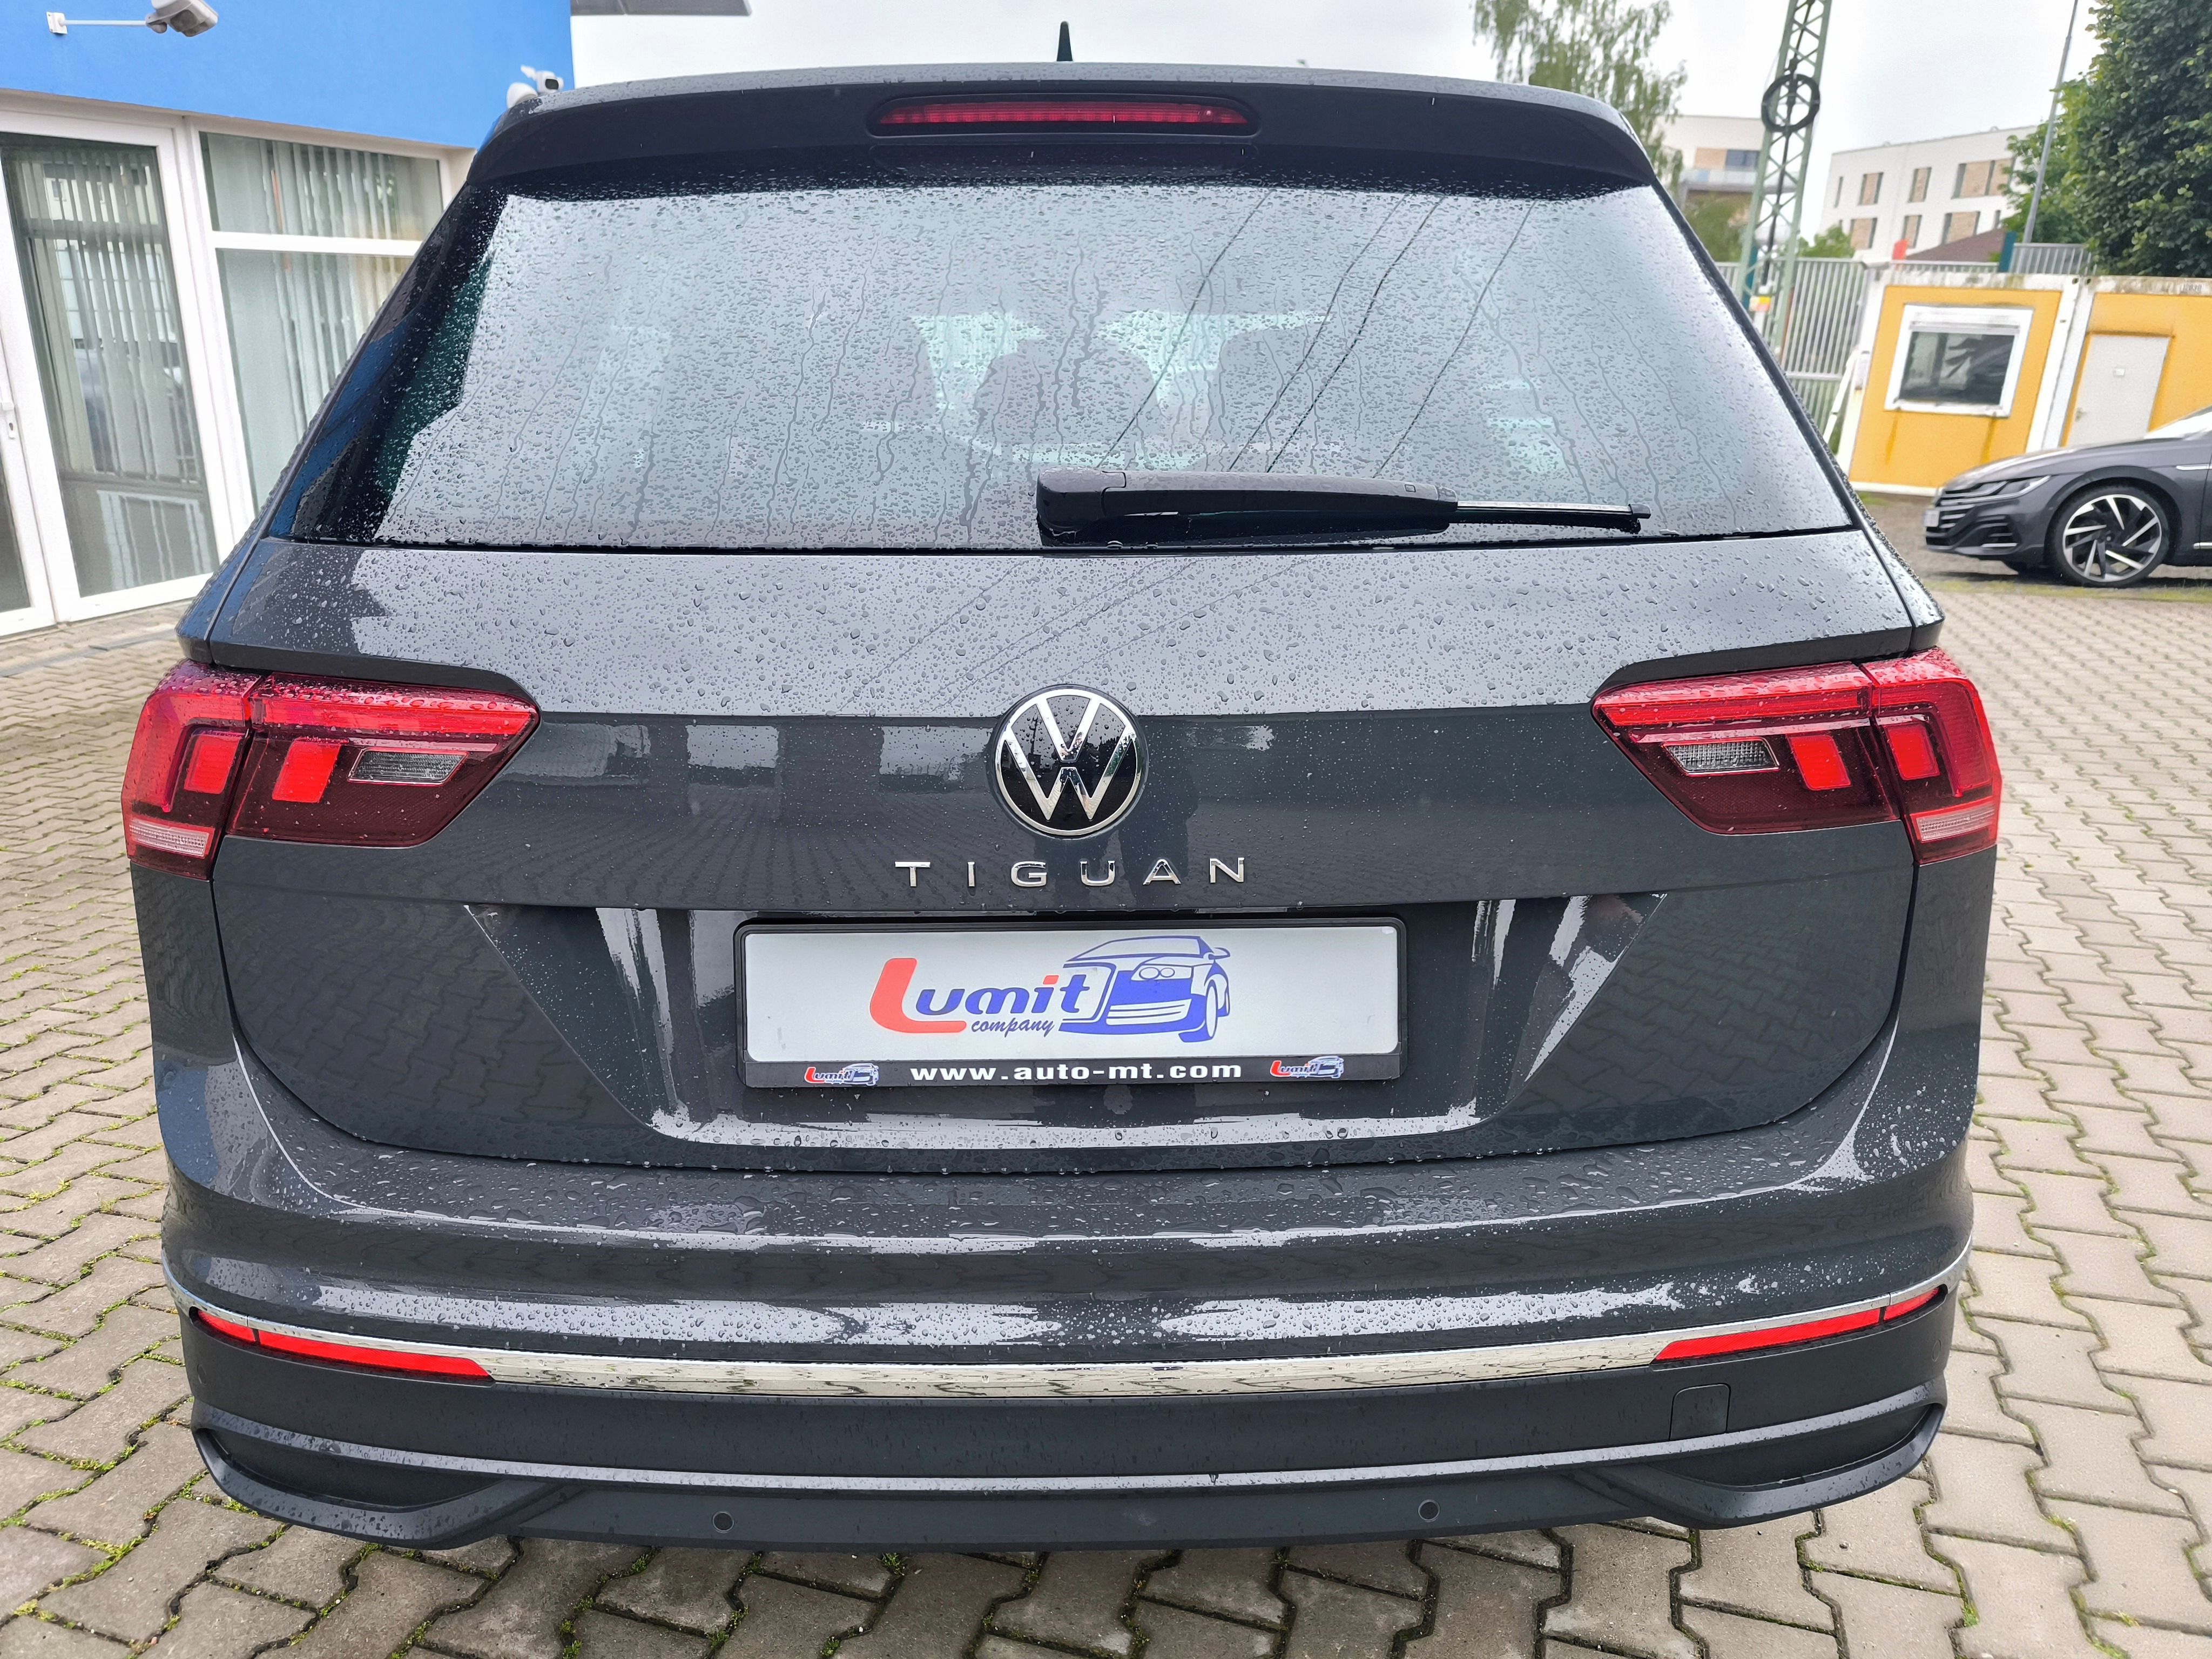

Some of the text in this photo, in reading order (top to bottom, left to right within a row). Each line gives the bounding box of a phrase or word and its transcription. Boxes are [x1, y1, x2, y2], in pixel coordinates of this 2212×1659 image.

[895, 857, 1244, 887] TIGUAN
[869, 957, 1090, 1033] Lumit
[972, 1017, 1055, 1037] company
[805, 1067, 852, 1083] Lumit
[910, 1063, 1242, 1081] www.auto-mt.com
[1271, 1061, 1317, 1076] Lumit
